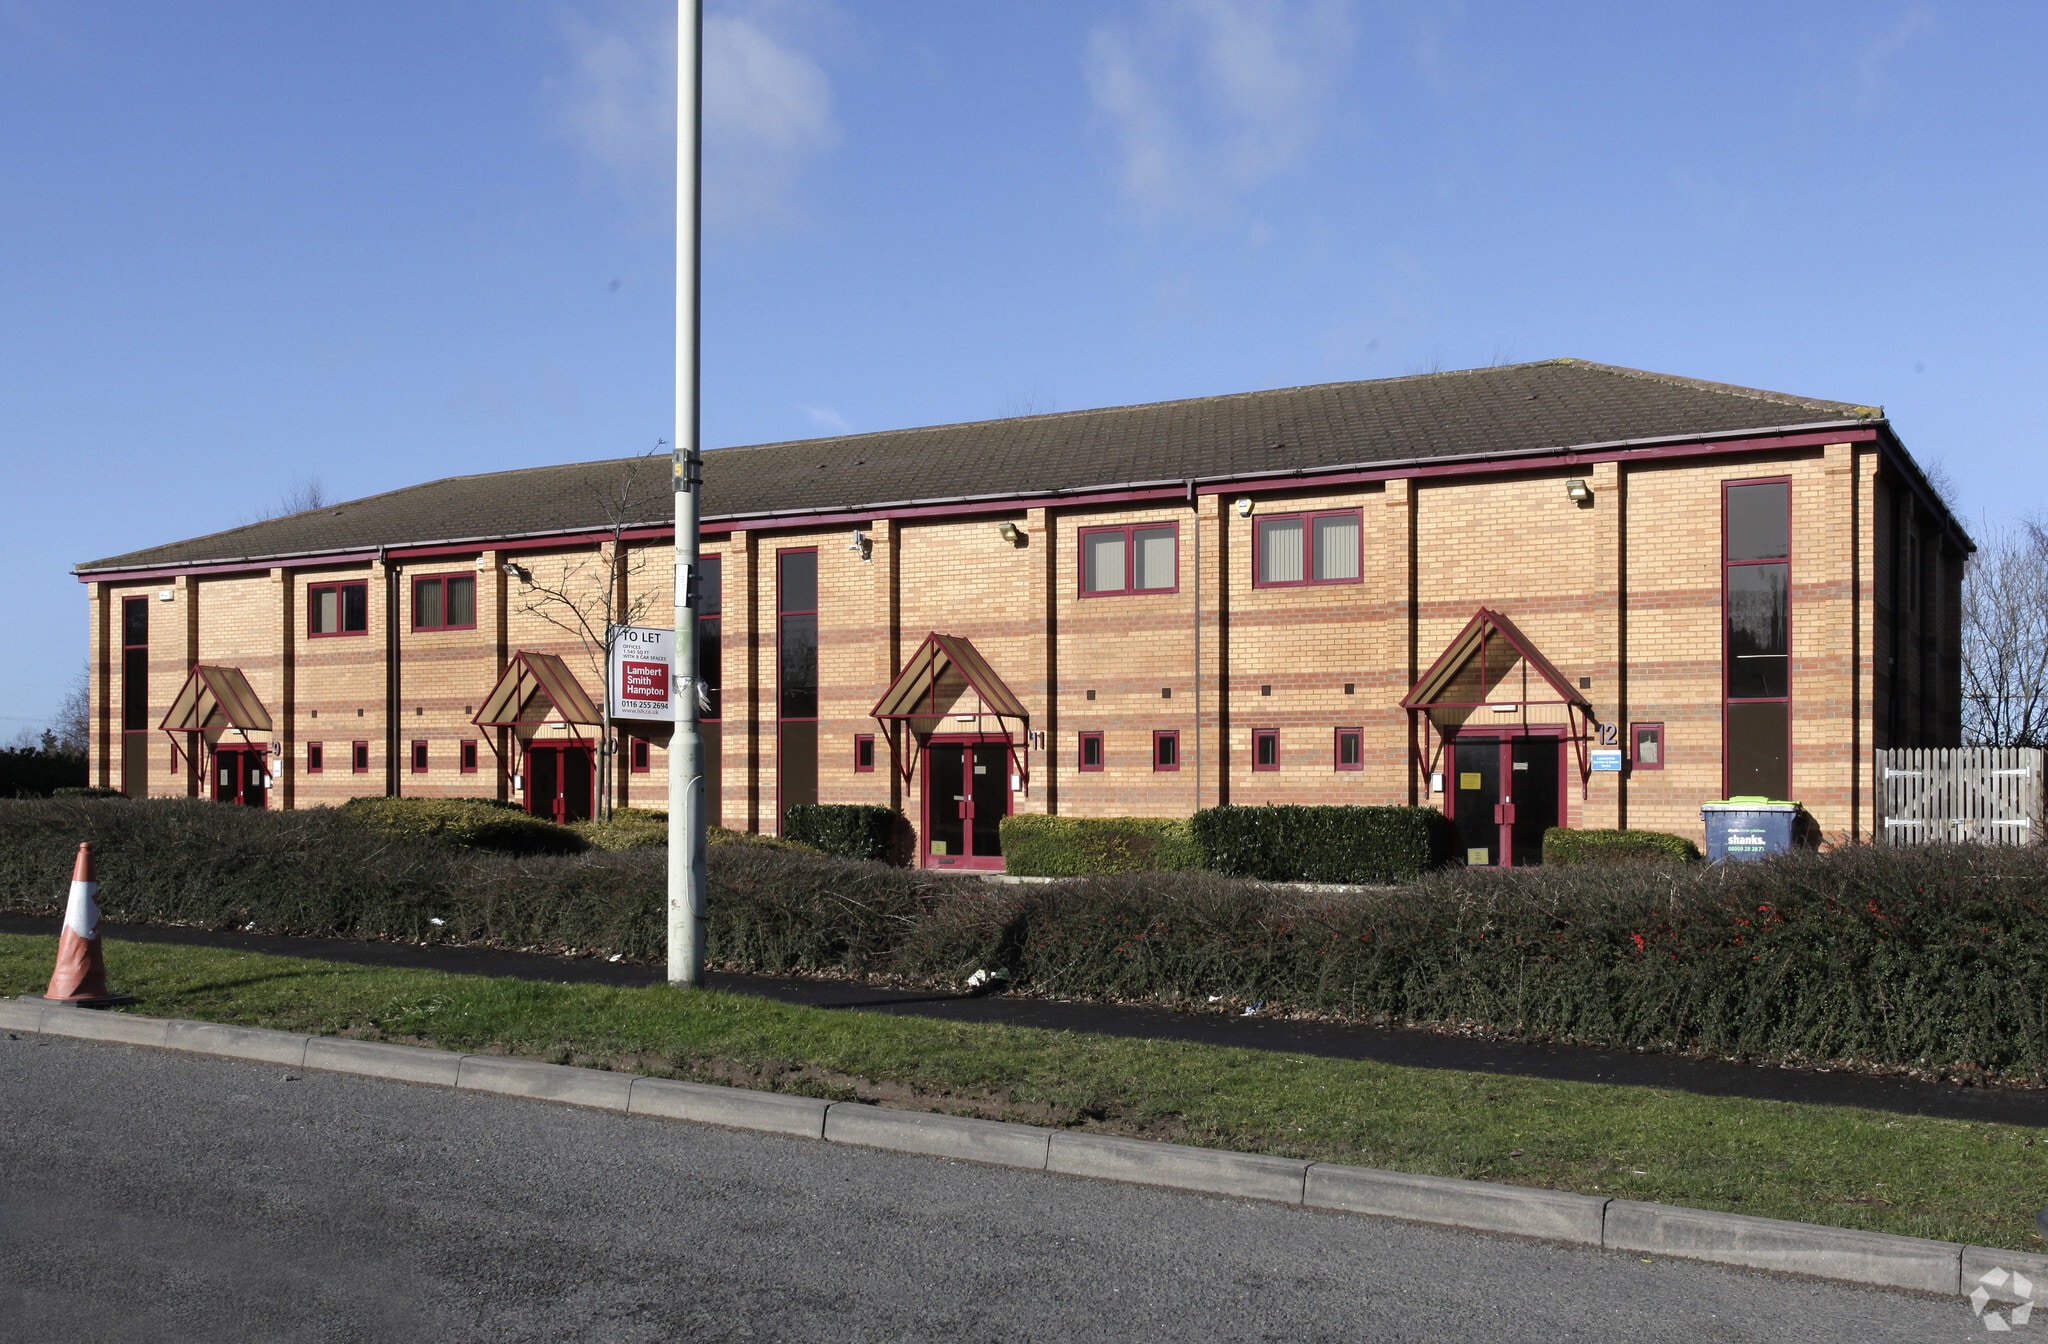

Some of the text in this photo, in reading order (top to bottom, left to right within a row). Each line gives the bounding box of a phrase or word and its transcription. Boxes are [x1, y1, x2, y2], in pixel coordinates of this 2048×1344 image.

[674, 463, 682, 477] 5
[622, 631, 661, 643] TO LET
[627, 665, 662, 677] Lambert
[627, 675, 651, 685] Smith
[627, 685, 664, 696] Hampton
[622, 700, 668, 710] 0116 255 2694
[1599, 723, 1617, 746] 12
[1727, 834, 1766, 845] shanks.
